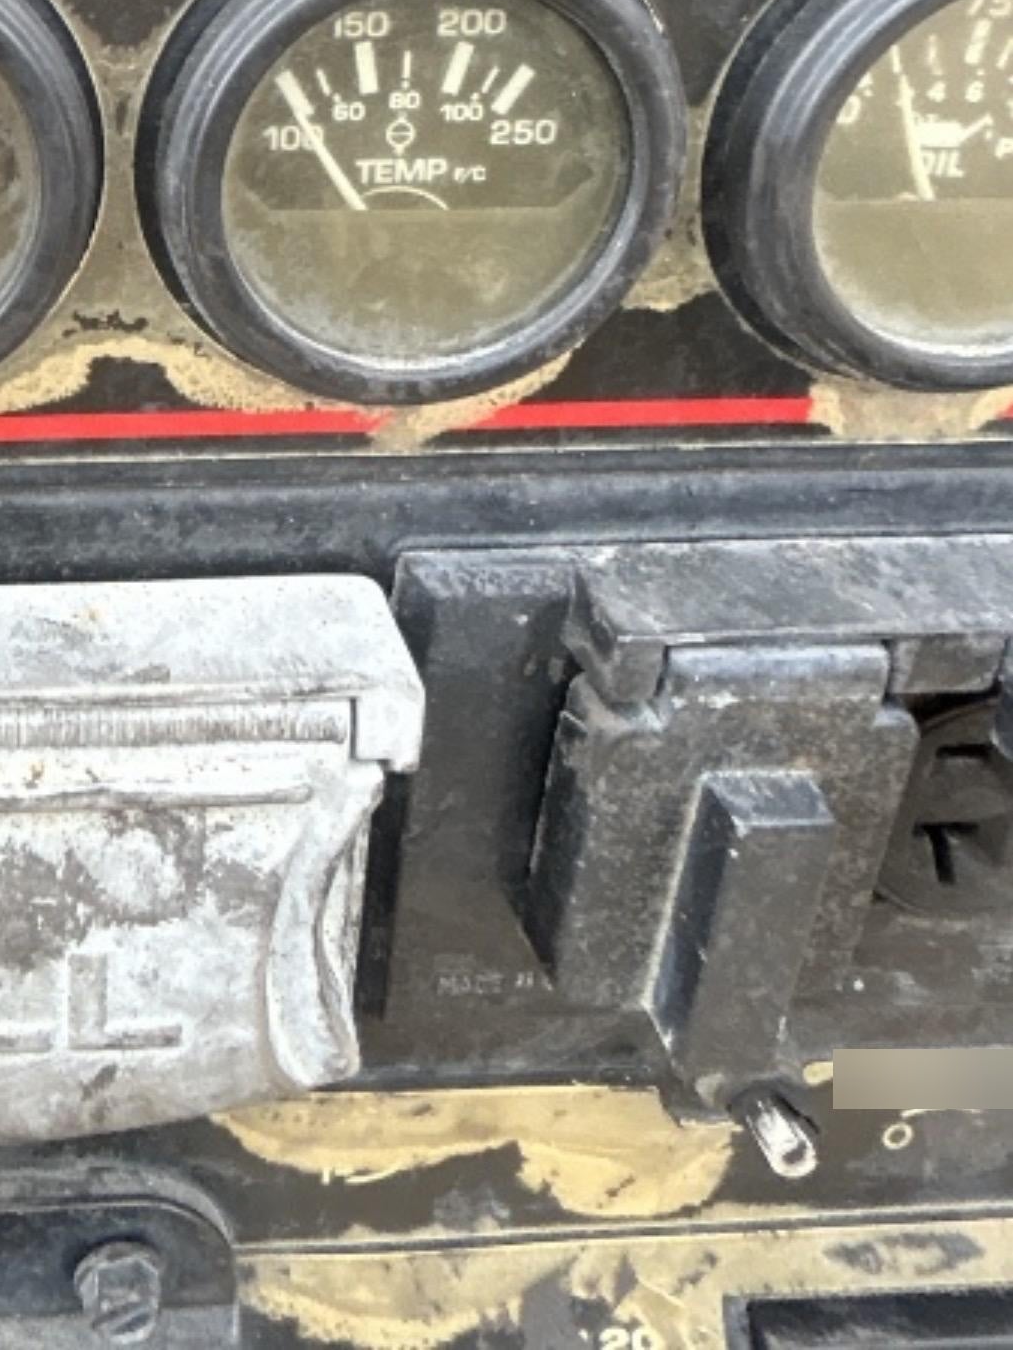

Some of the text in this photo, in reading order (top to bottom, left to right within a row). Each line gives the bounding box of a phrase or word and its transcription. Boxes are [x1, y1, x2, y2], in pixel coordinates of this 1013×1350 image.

[333, 11, 390, 38] 150
[437, 9, 507, 37] 200
[440, 103, 483, 121] 100
[490, 119, 557, 145] 250
[355, 159, 448, 185] TEMP
